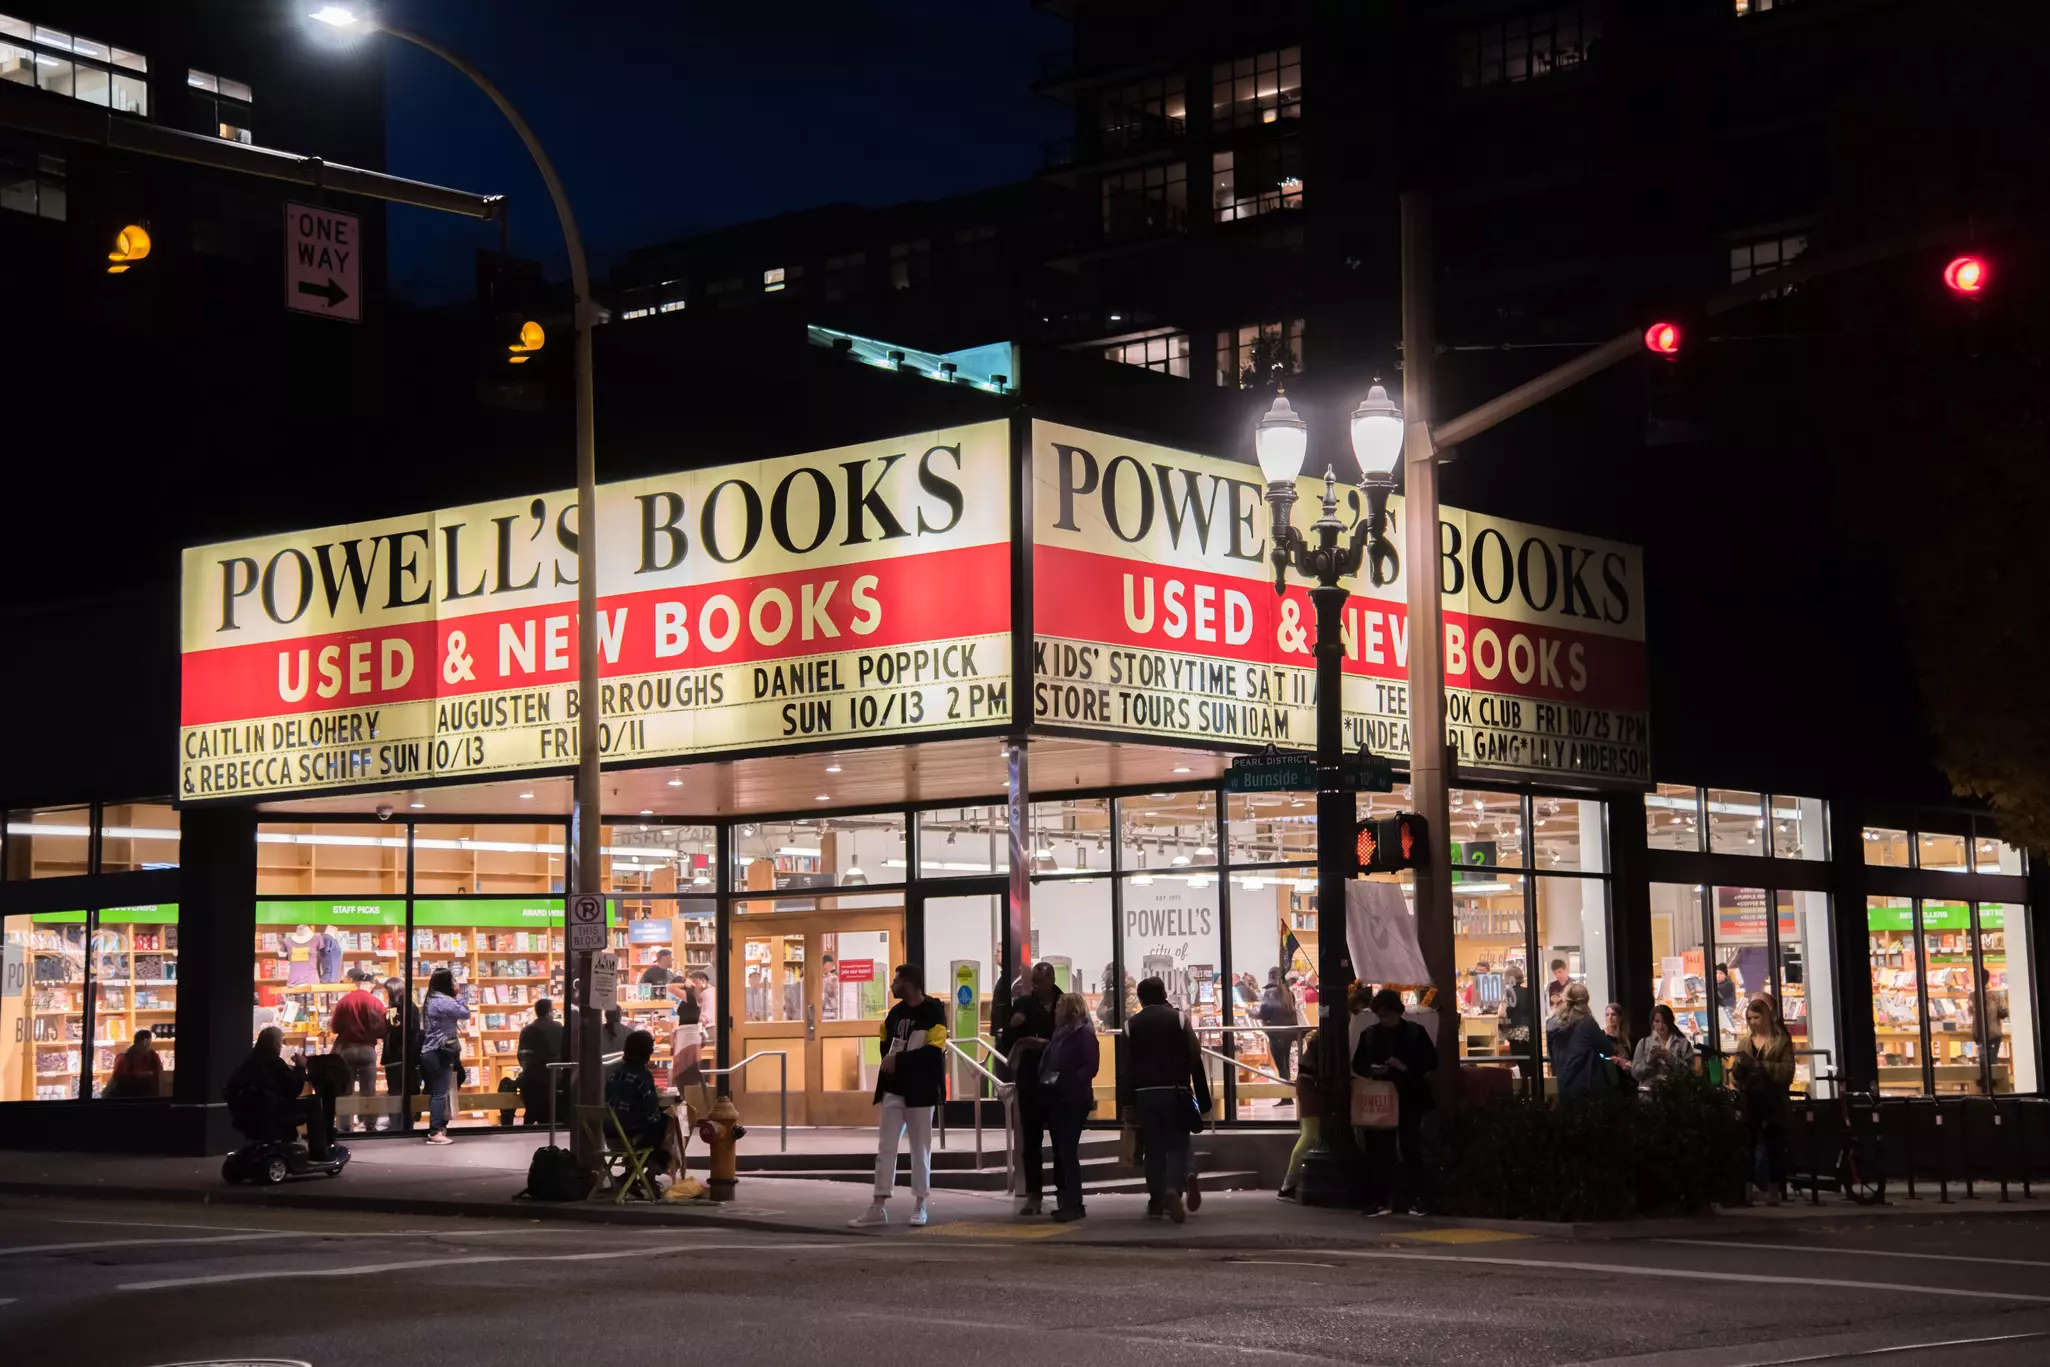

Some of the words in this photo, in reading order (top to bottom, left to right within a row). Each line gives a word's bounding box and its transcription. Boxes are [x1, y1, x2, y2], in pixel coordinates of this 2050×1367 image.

[299, 213, 348, 245] ONE
[298, 242, 349, 273] WAY
[216, 498, 580, 632] POWELL'S
[633, 442, 964, 576] BOOKS
[1050, 442, 1400, 586] POWE'
[1439, 520, 1630, 625] BOOKS
[278, 638, 415, 703] USED
[443, 630, 476, 685] &
[498, 607, 628, 677] NEW
[655, 574, 882, 659] BOOKS
[1123, 573, 1253, 646] USED
[1277, 598, 1310, 655] &
[1445, 624, 1588, 693] BOOKS
[754, 659, 845, 699] DANIEL
[859, 643, 978, 689] POPPICK
[1034, 640, 1100, 680] KIDS'
[1110, 651, 1236, 696] STORYTIME
[1246, 667, 1285, 702] SAT
[437, 690, 551, 734] AUGUSTEN
[567, 672, 724, 720] BRROUGHS
[782, 700, 832, 736] SUN
[850, 690, 924, 731] 10/13
[947, 687, 960, 719] 2
[970, 681, 1008, 718] PM
[1035, 682, 1111, 724] STORE
[1119, 691, 1190, 730] TOURS
[1376, 684, 1407, 715] TEE
[1479, 698, 1522, 728] CLUB
[1536, 704, 1562, 734] FRI
[1567, 707, 1611, 740] 10/25
[1616, 714, 1648, 745] 7PM
[185, 723, 265, 760] CAITLIN
[272, 710, 380, 750] DELOHERY
[540, 727, 579, 760] FRI
[598, 719, 645, 752] 0/11
[1344, 716, 1410, 752] UNDEA
[1569, 742, 1648, 776] ANDERSON
[183, 766, 194, 794] &
[201, 756, 292, 794] REBECCA
[300, 746, 372, 783] SCHIFF
[380, 741, 420, 775] SUN
[427, 735, 485, 770] 10/13
[1233, 757, 1264, 767] PEARL
[1266, 755, 1308, 765] DISTRICT
[1244, 769, 1299, 787] Burnside
[332, 905, 356, 914] STAFF
[357, 906, 380, 914] PICKS
[577, 926, 599, 937] THIS
[1126, 908, 1211, 938] POWELL'S
[574, 935, 603, 946] BLOCK
[1175, 942, 1188, 961] of
